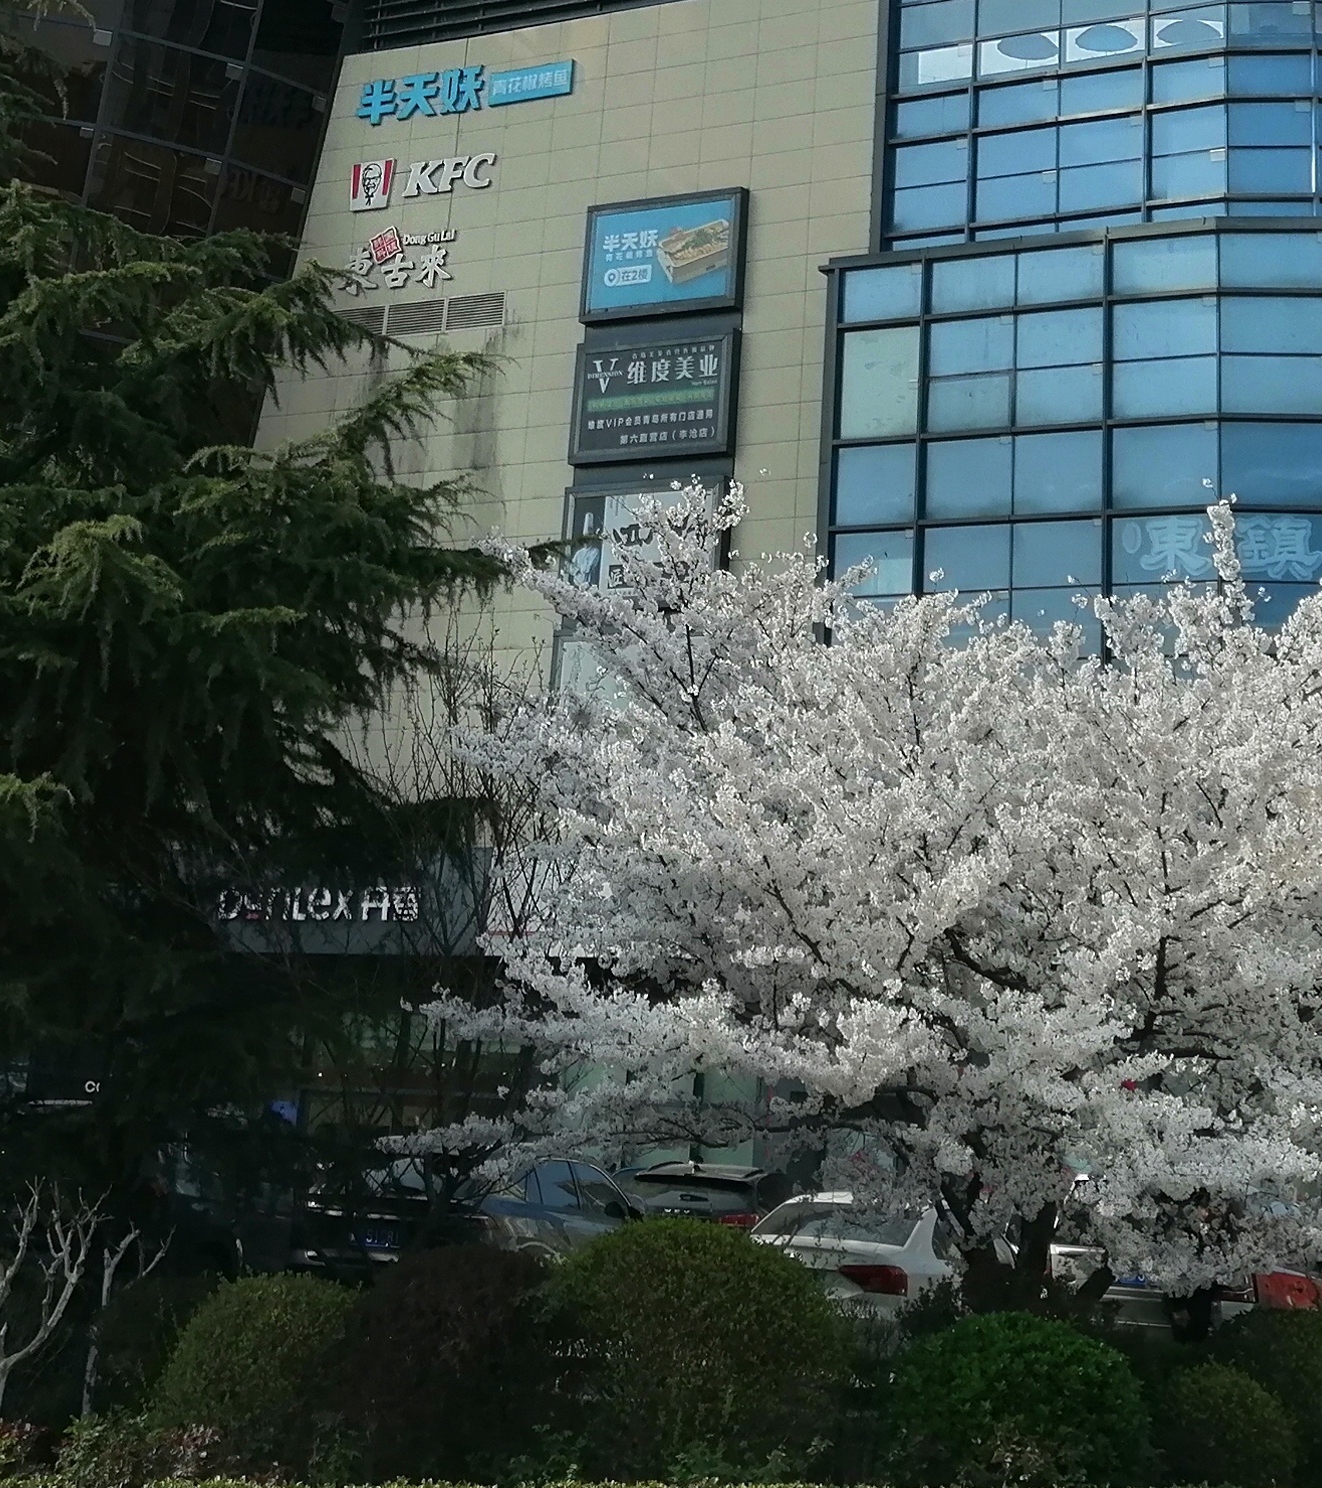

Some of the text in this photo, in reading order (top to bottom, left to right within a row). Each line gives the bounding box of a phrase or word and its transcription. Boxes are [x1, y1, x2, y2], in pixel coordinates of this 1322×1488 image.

[356, 64, 486, 126] 半天妖
[402, 153, 496, 198] KFC
[603, 229, 659, 252] 半天妖
[627, 354, 719, 384] 维度美业
